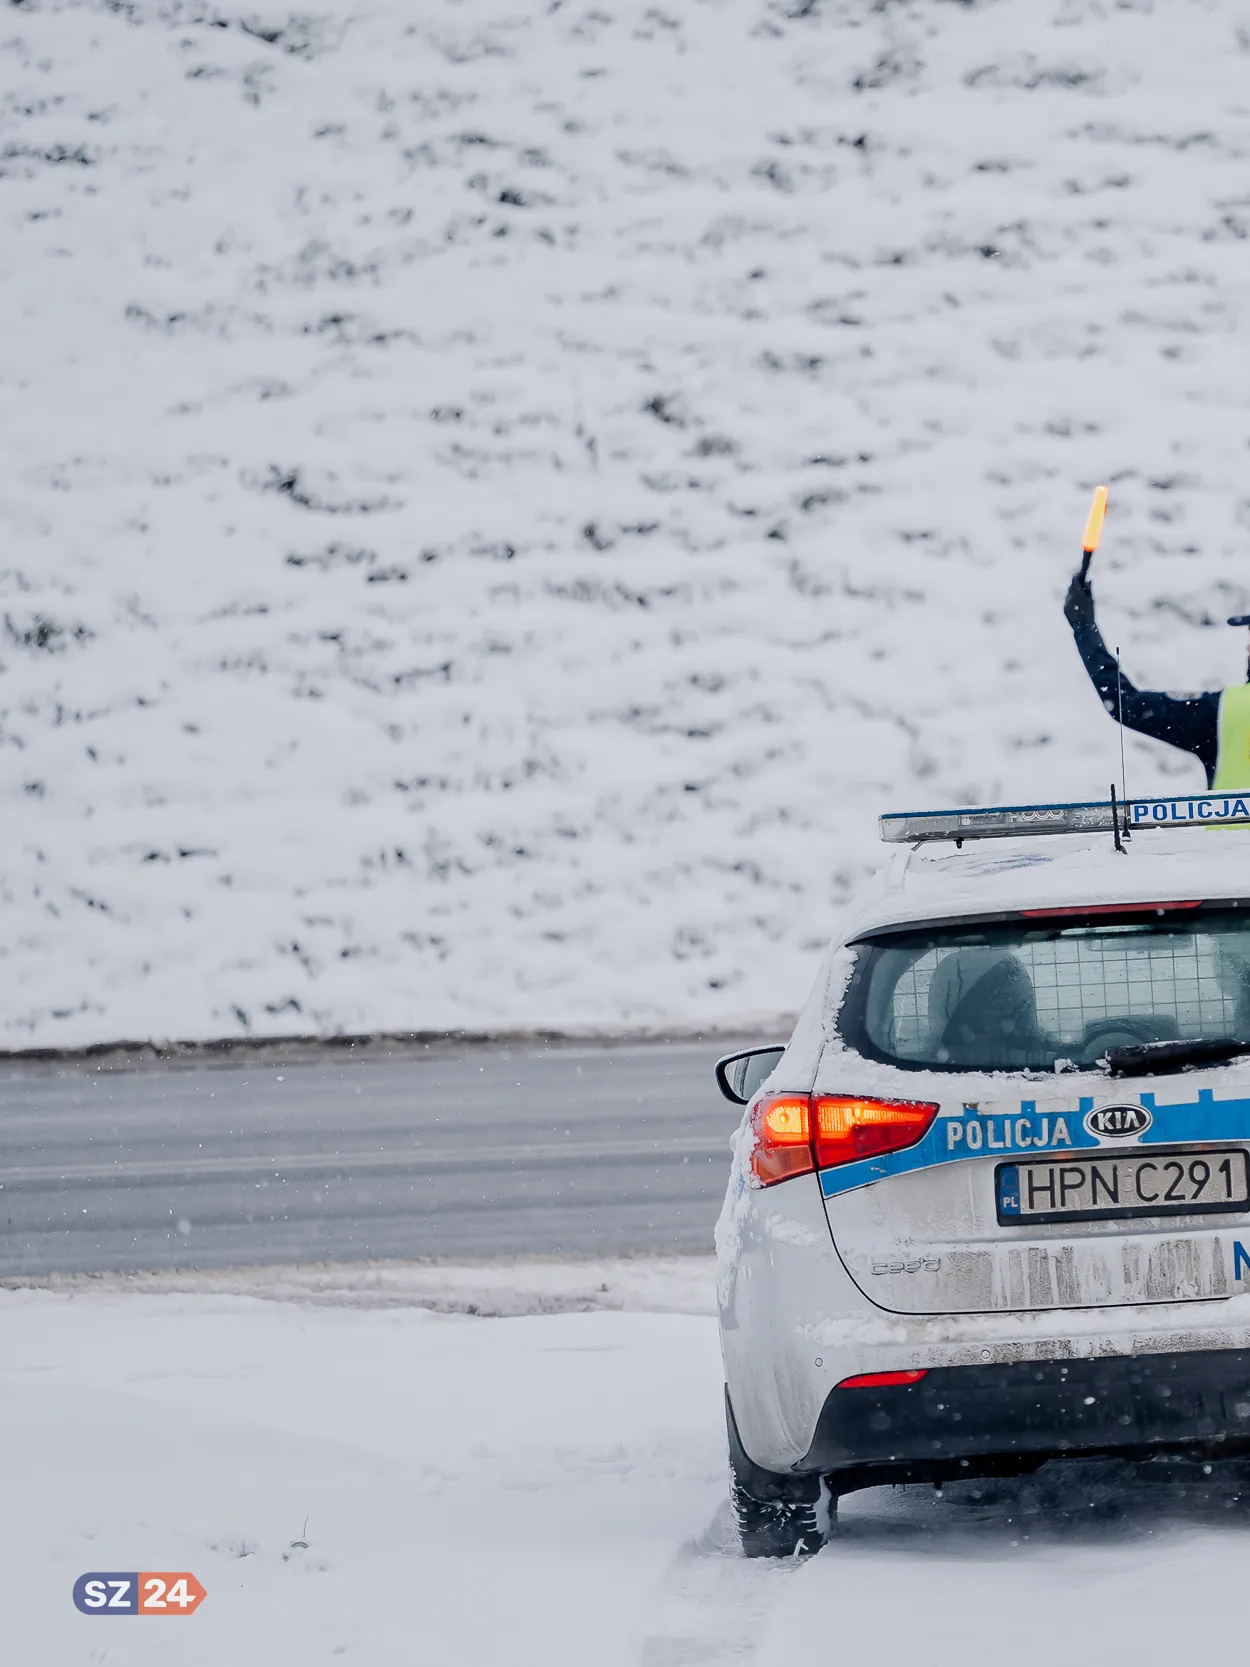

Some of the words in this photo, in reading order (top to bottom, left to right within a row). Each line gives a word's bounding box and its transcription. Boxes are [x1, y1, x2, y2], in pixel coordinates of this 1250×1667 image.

[1133, 799, 1250, 822] POLICJA
[1097, 1110, 1141, 1131] KIA
[947, 1117, 1072, 1150] POLICJA
[1027, 1164, 1119, 1210] HPN
[1135, 1159, 1234, 1202] C291
[1003, 1196, 1019, 1208] PL
